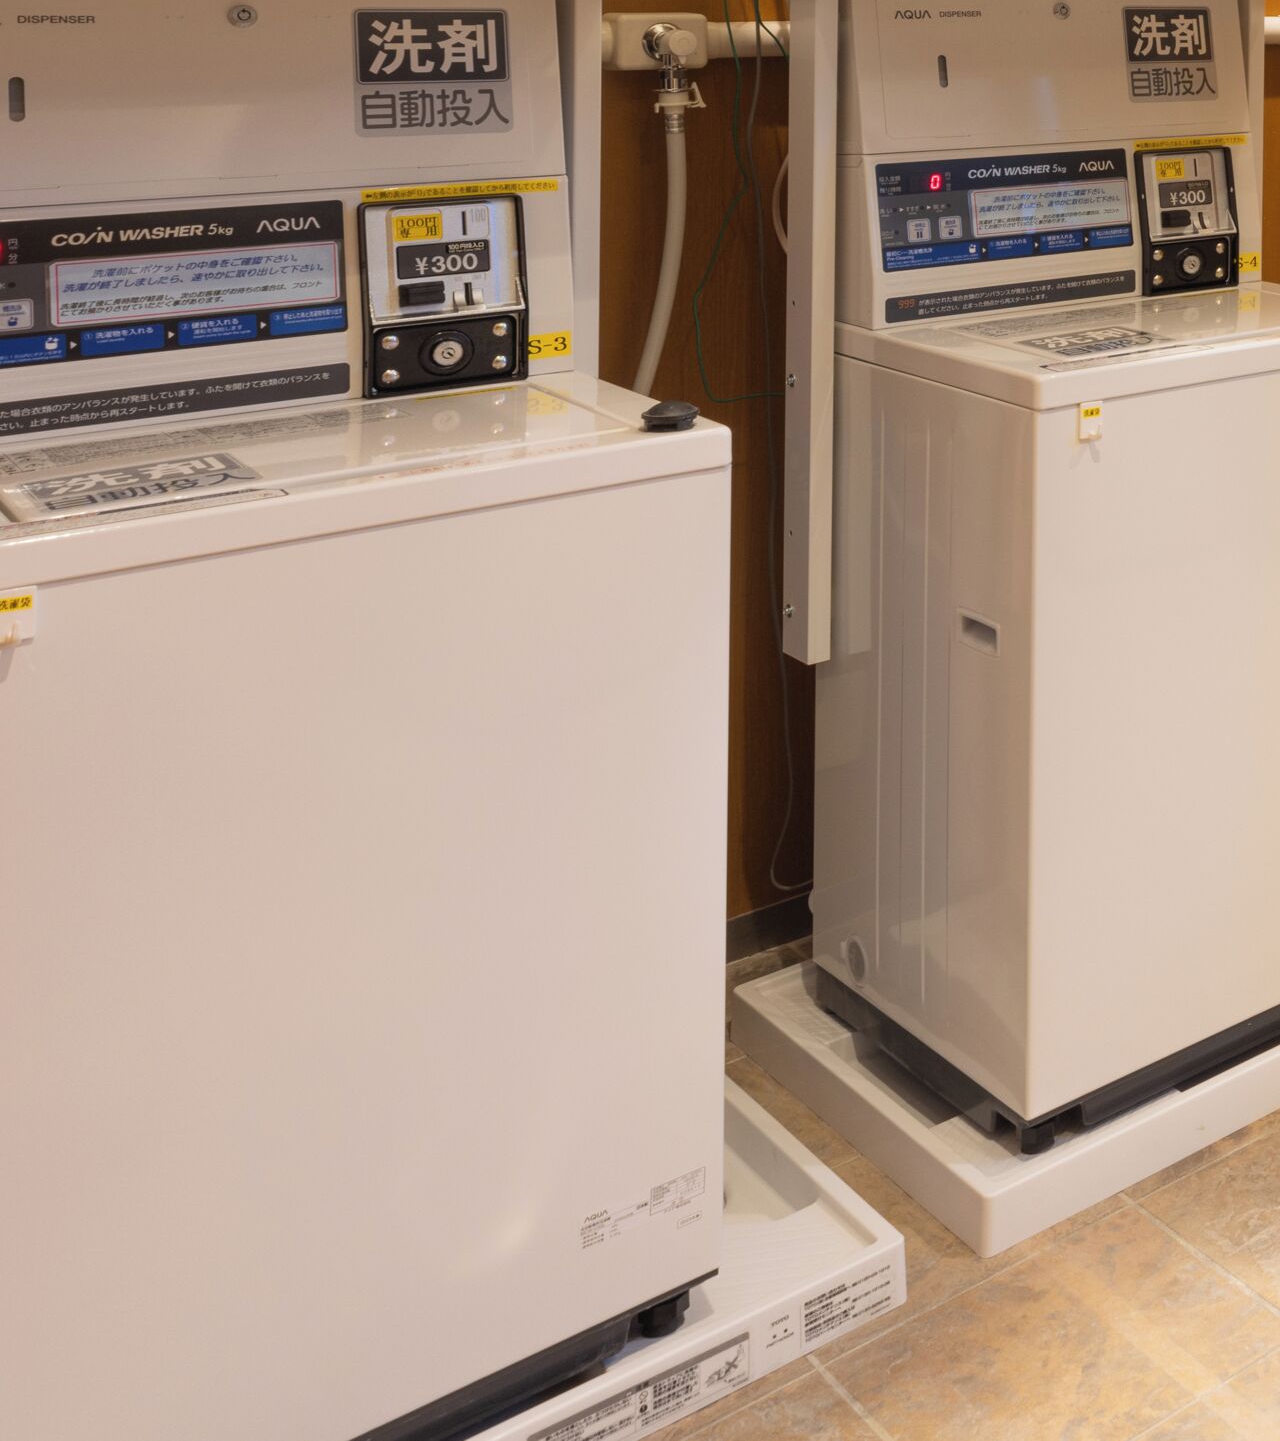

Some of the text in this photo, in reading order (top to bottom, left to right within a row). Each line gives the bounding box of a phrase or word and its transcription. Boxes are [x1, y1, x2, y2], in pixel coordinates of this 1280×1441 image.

[17, 15, 96, 24] DISPENSER
[895, 10, 982, 20] AQUA DISPENSER
[1131, 15, 1208, 56] 洗剤
[368, 19, 498, 75] 洗剤
[1131, 67, 1216, 97] 自動投入
[362, 89, 510, 130] 自動投入
[968, 160, 1115, 179] COIN WASHER 5kg AQUA
[930, 174, 941, 189] 0
[1170, 190, 1206, 205] ¥300
[399, 217, 438, 229] 100円
[470, 208, 486, 223] 100
[51, 216, 321, 246] COIN WASHER 5kg AQUA
[92, 254, 299, 278] 洗濯前にポケットの中身をご確認下さい。
[415, 253, 478, 275] ¥300
[62, 264, 325, 293] 洗濯が終了しましたら、速やかに取り出して下さい。
[898, 298, 916, 310] 999
[96, 327, 154, 340] 洗濯物を入れる
[191, 318, 239, 330] 硬貨を入れる
[528, 336, 567, 355] S-3
[1031, 328, 1140, 349] 洗剤
[51, 457, 227, 495] 洗剤
[584, 1209, 608, 1223] AQUA
